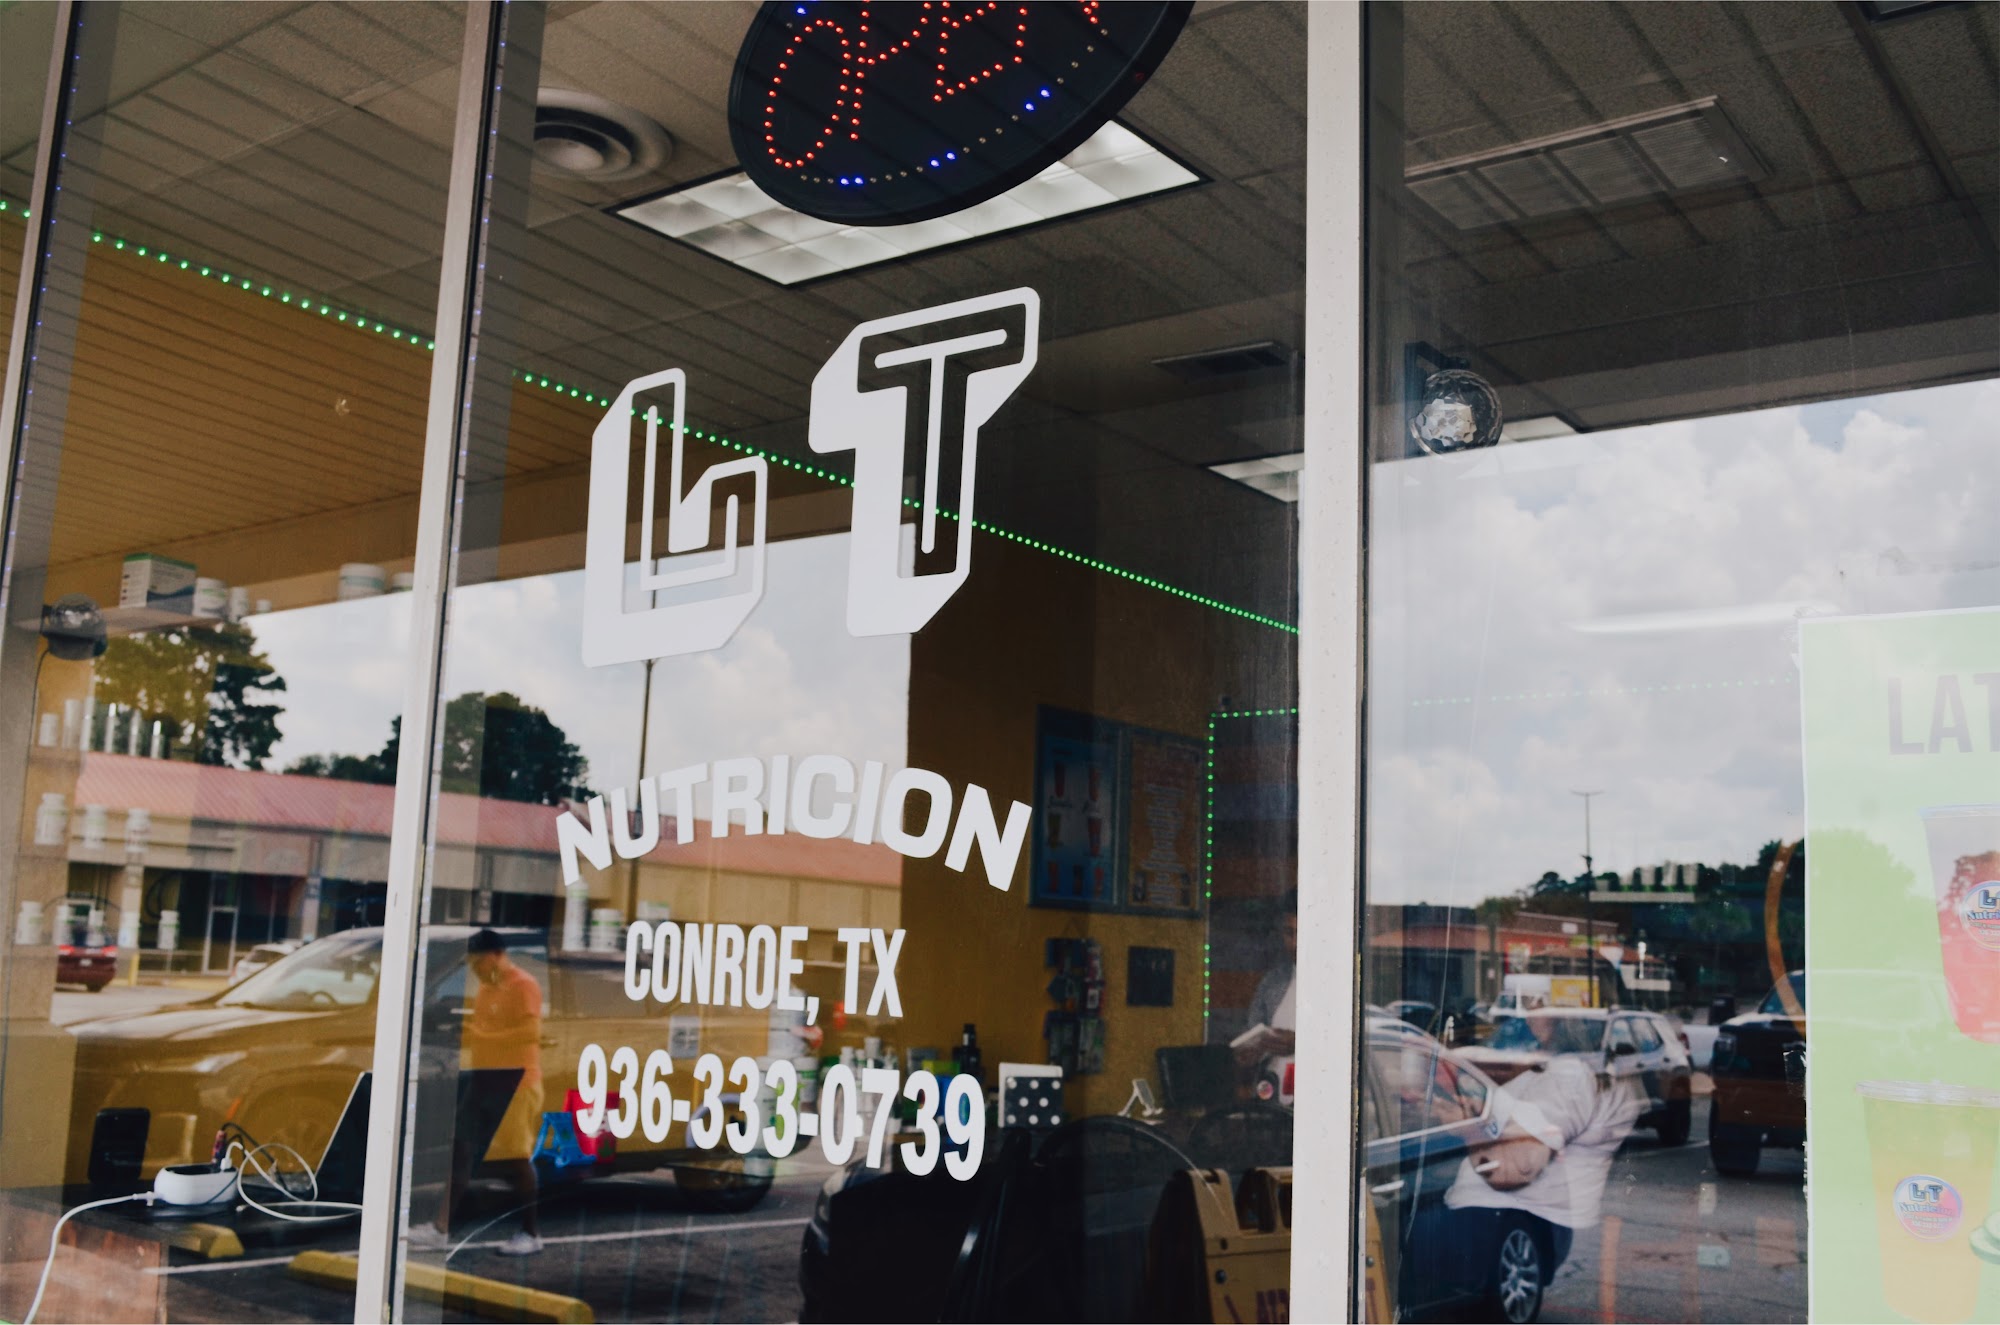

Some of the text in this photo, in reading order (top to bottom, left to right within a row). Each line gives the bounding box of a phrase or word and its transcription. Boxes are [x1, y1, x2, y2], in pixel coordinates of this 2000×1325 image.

[582, 286, 1040, 668] LT
[555, 754, 1033, 892] NUTRICION
[623, 920, 907, 1026] CONROE, TX
[575, 1043, 986, 1182] 936-333-0739
[1908, 1182, 1943, 1203] LT
